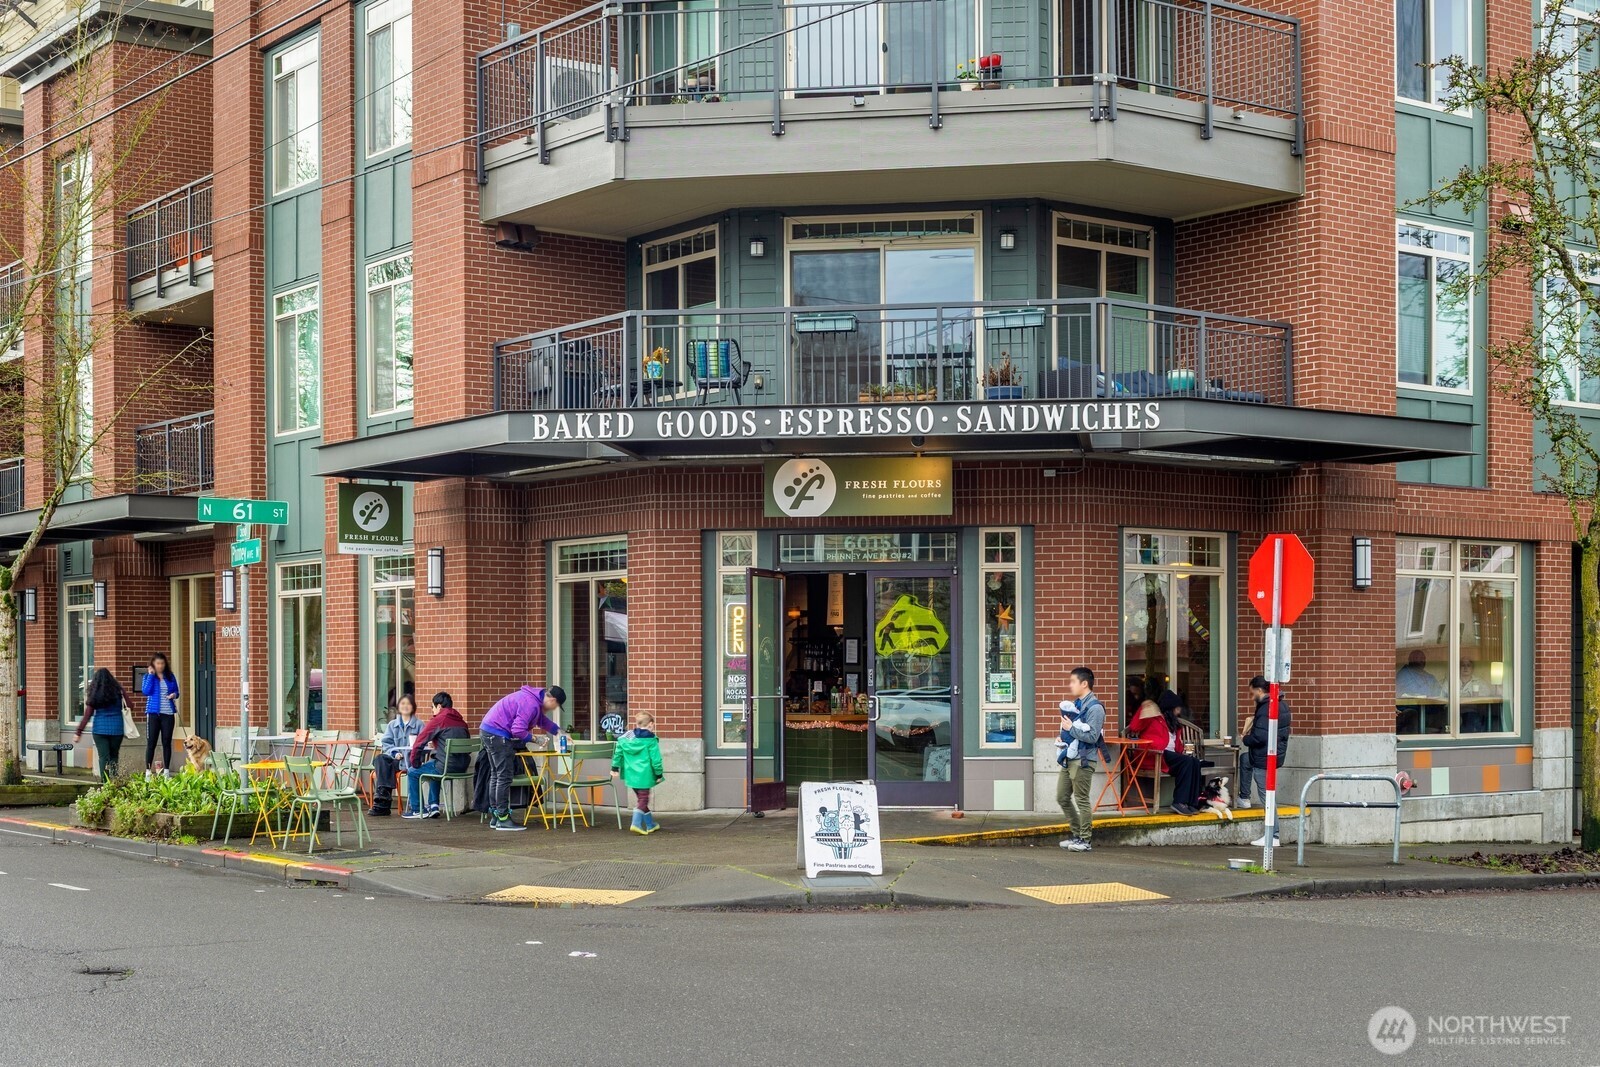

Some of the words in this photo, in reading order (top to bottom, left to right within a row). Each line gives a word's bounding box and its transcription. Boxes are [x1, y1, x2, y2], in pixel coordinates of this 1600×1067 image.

[532, 412, 634, 440] BAKED
[656, 410, 757, 438] GOODS
[778, 405, 935, 435] ESPRESSO
[956, 402, 1161, 432] SANDWICHES
[845, 480, 887, 489] FRESH
[893, 479, 942, 489] FLOURS
[203, 503, 212, 516] N
[232, 502, 253, 520] 61
[272, 508, 285, 518] ST
[344, 533, 369, 541] FRESH
[371, 534, 399, 542] FLOURS
[844, 535, 892, 552] 6015
[826, 552, 861, 560] PHINNEY
[862, 552, 878, 560] AVE
[733, 605, 745, 654] OPEN
[814, 786, 832, 794] FRESH
